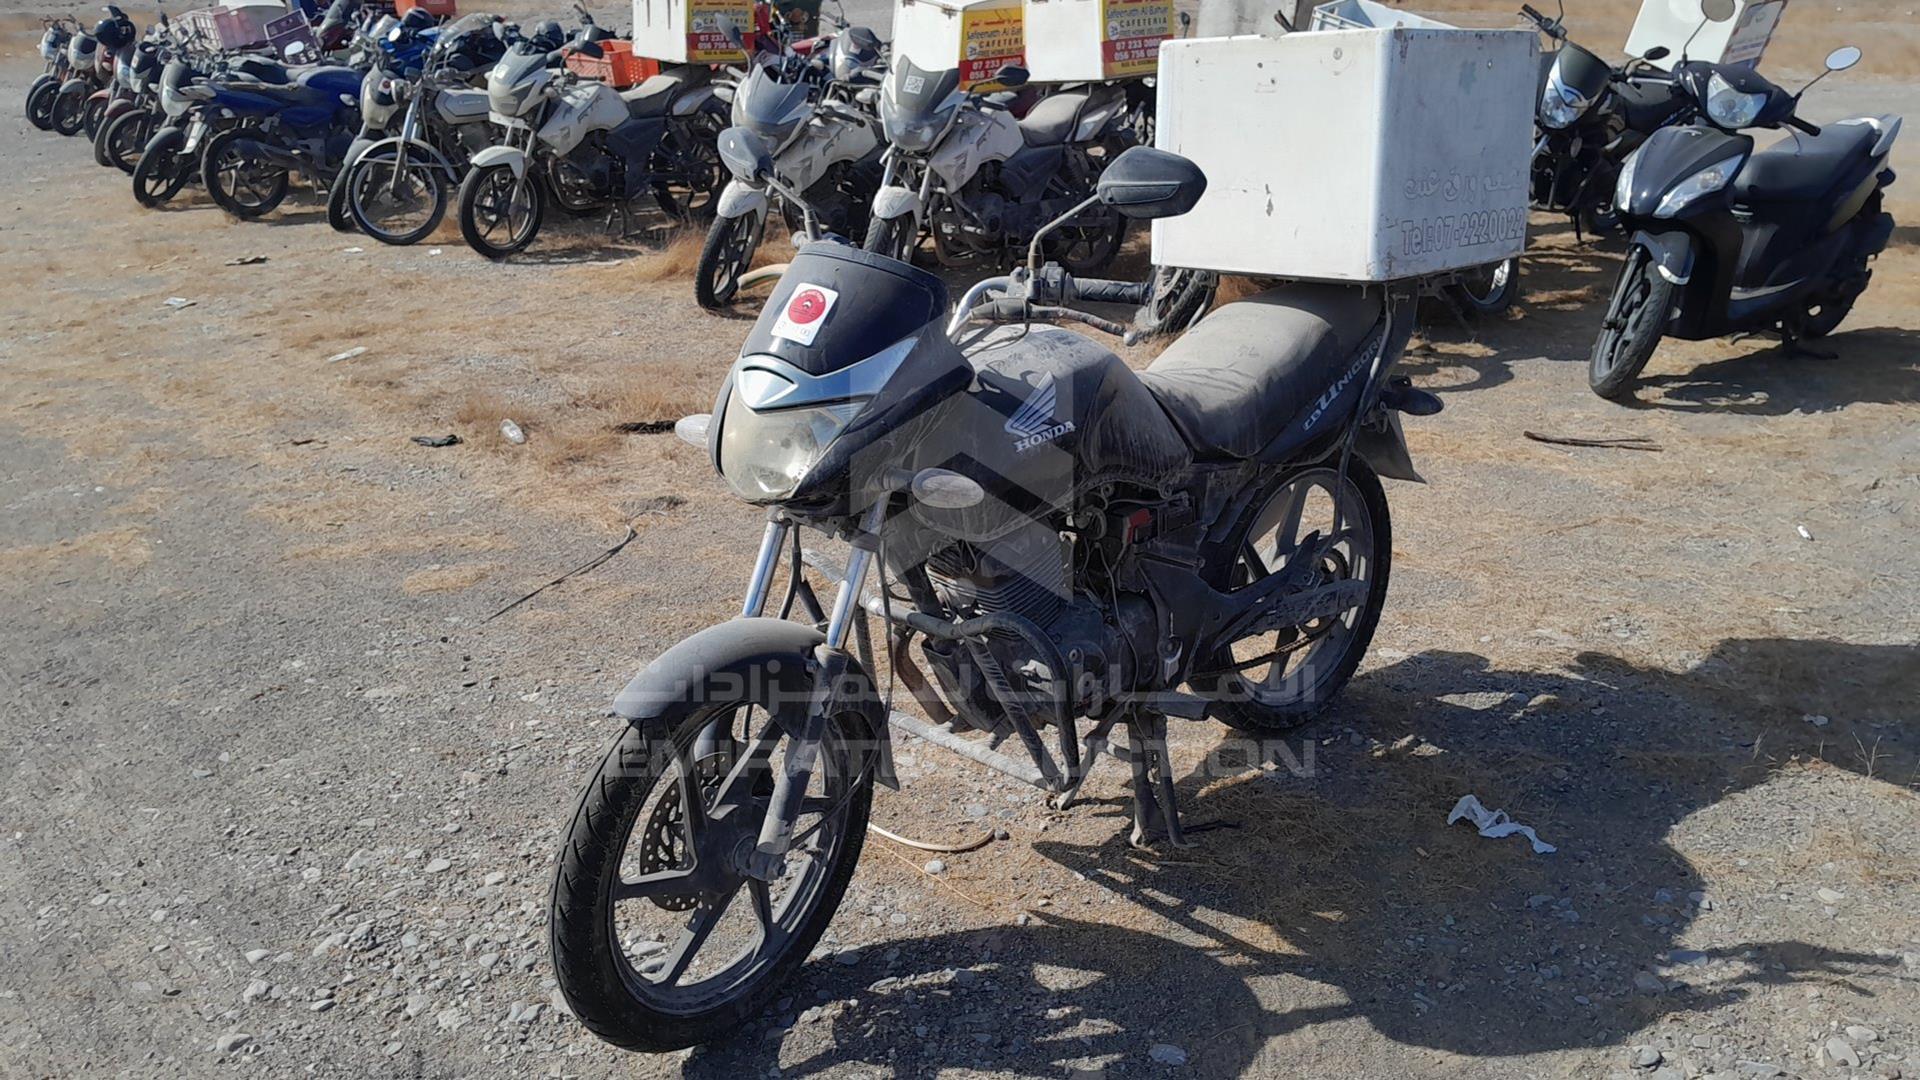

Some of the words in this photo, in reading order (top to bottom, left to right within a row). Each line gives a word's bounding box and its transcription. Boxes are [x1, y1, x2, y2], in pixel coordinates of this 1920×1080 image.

[1119, 17, 1167, 28] CAFETERIA
[1115, 40, 1126, 51] 07
[1127, 39, 1142, 50] 233
[972, 60, 984, 70] 07
[985, 59, 1000, 69] 233
[969, 70, 985, 80] 056
[1013, 420, 1076, 454] HONDA
